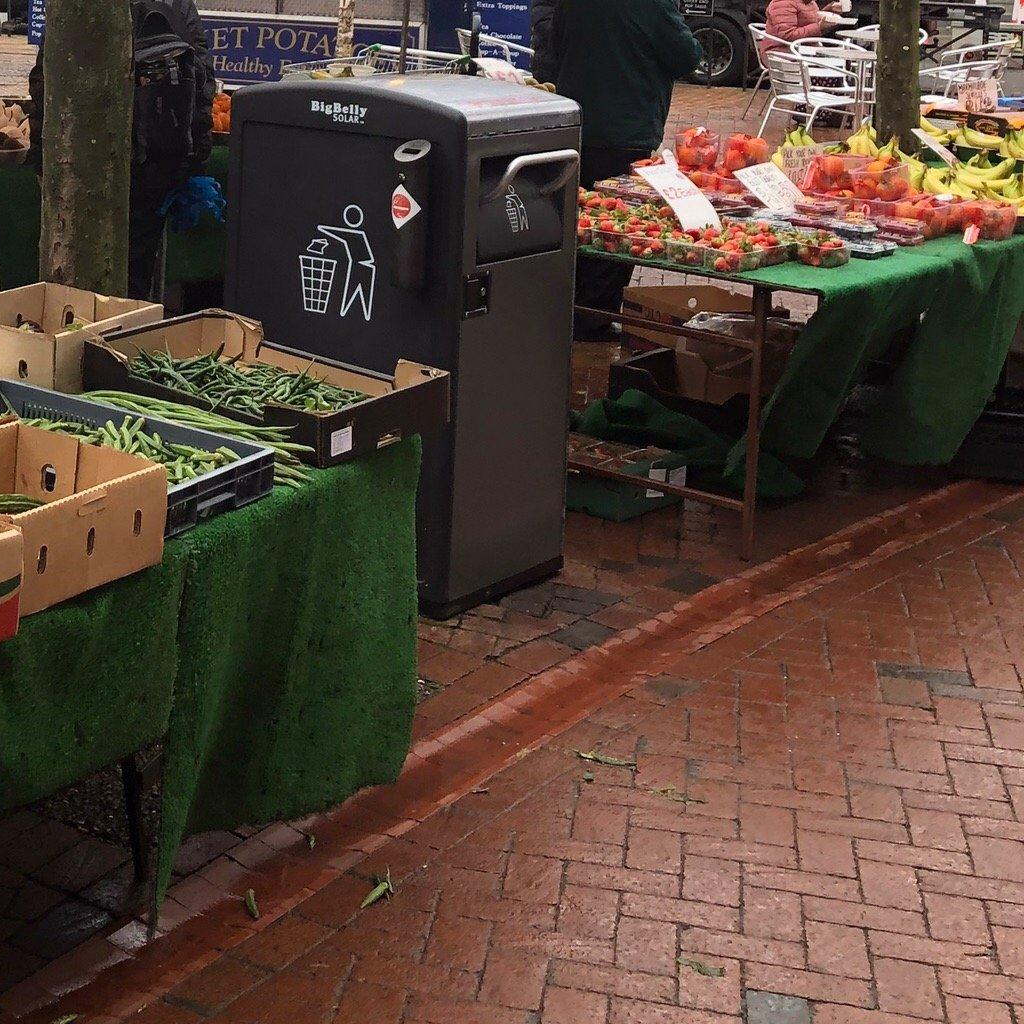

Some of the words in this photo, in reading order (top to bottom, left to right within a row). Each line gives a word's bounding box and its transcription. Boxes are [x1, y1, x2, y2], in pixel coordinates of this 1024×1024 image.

[498, 2, 528, 11] Toppings
[212, 54, 273, 77] Healthy
[310, 100, 368, 119] BigBelly
[333, 113, 360, 124] SOLAR
